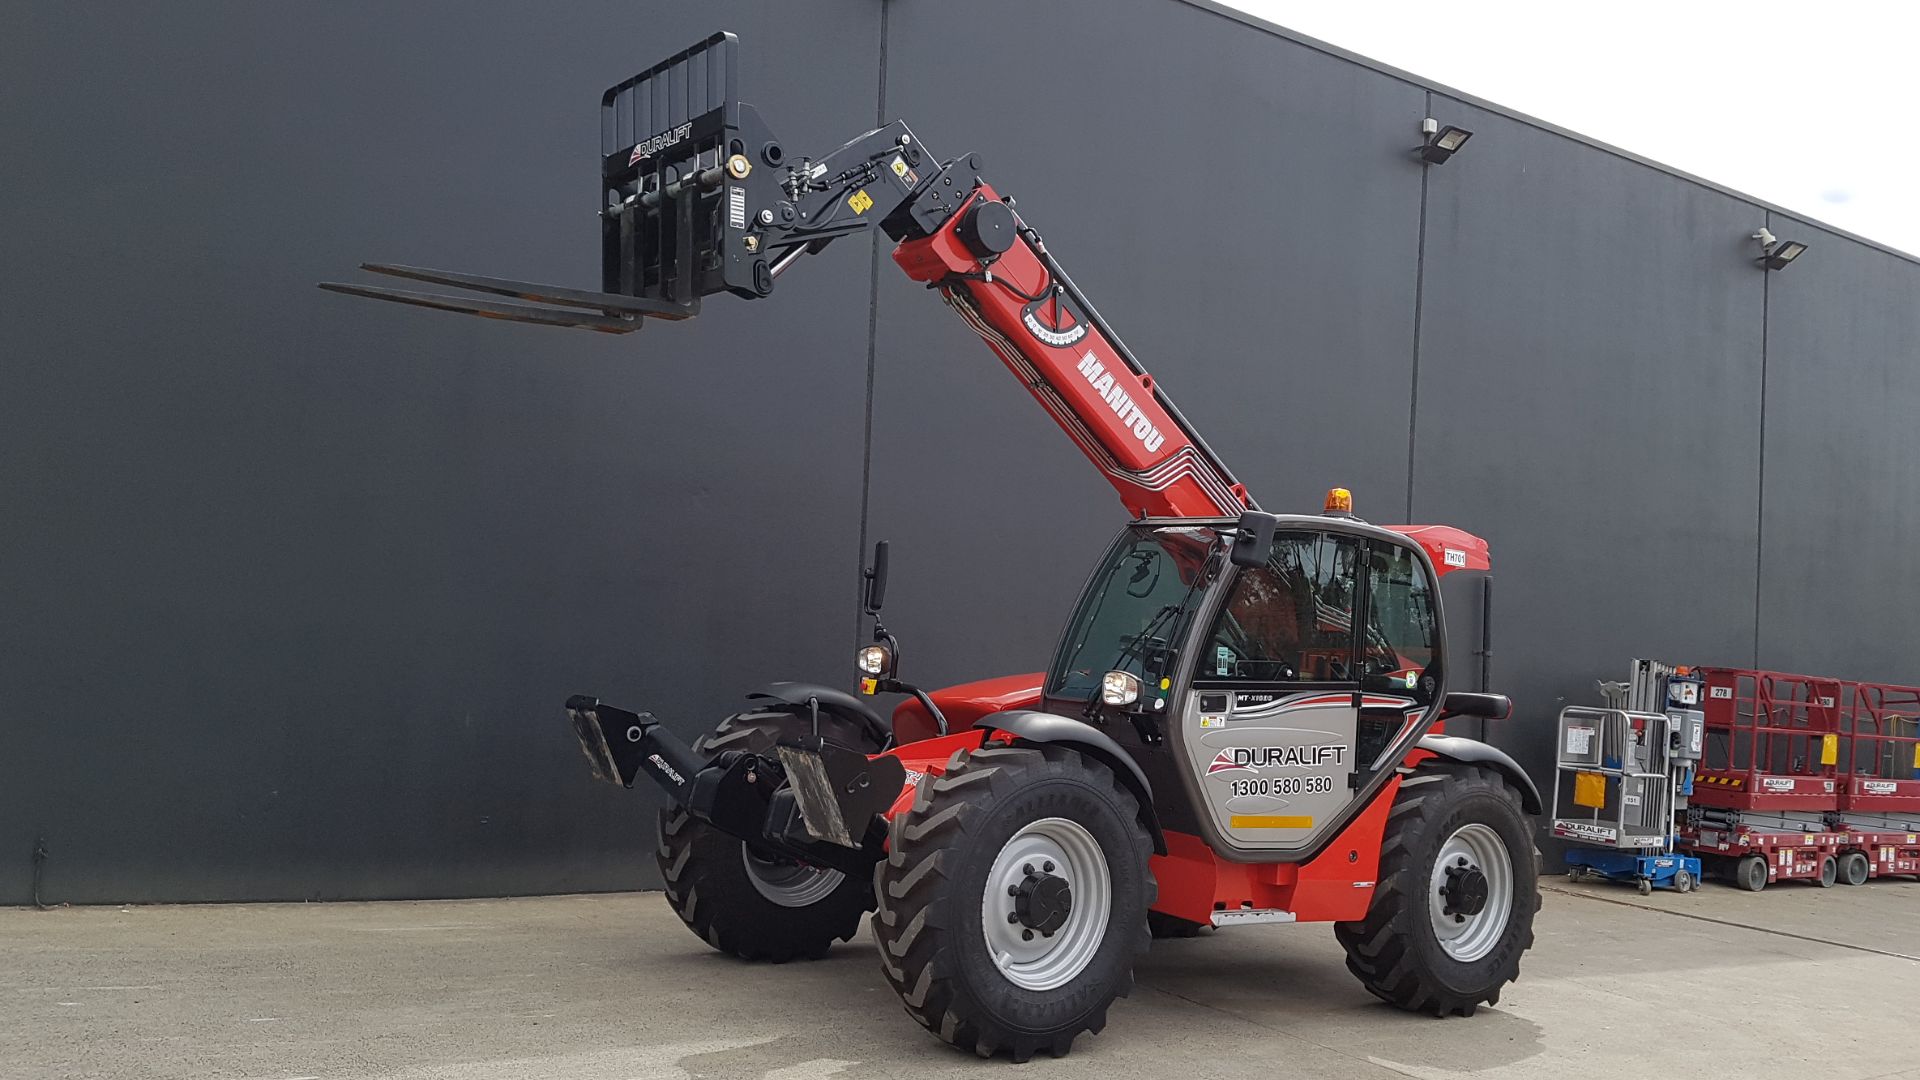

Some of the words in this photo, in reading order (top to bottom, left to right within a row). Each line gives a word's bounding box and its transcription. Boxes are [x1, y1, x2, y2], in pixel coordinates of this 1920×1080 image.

[639, 122, 693, 156] DURALIFT
[1077, 349, 1165, 453] MANITOU
[1446, 552, 1465, 563] TH701
[1715, 688, 1728, 697] 278
[1233, 745, 1348, 767] DURALIFT
[1231, 779, 1269, 797] 1300
[1273, 777, 1302, 796] 580
[1305, 775, 1334, 794] 580
[1565, 822, 1613, 835] DURALIFT
